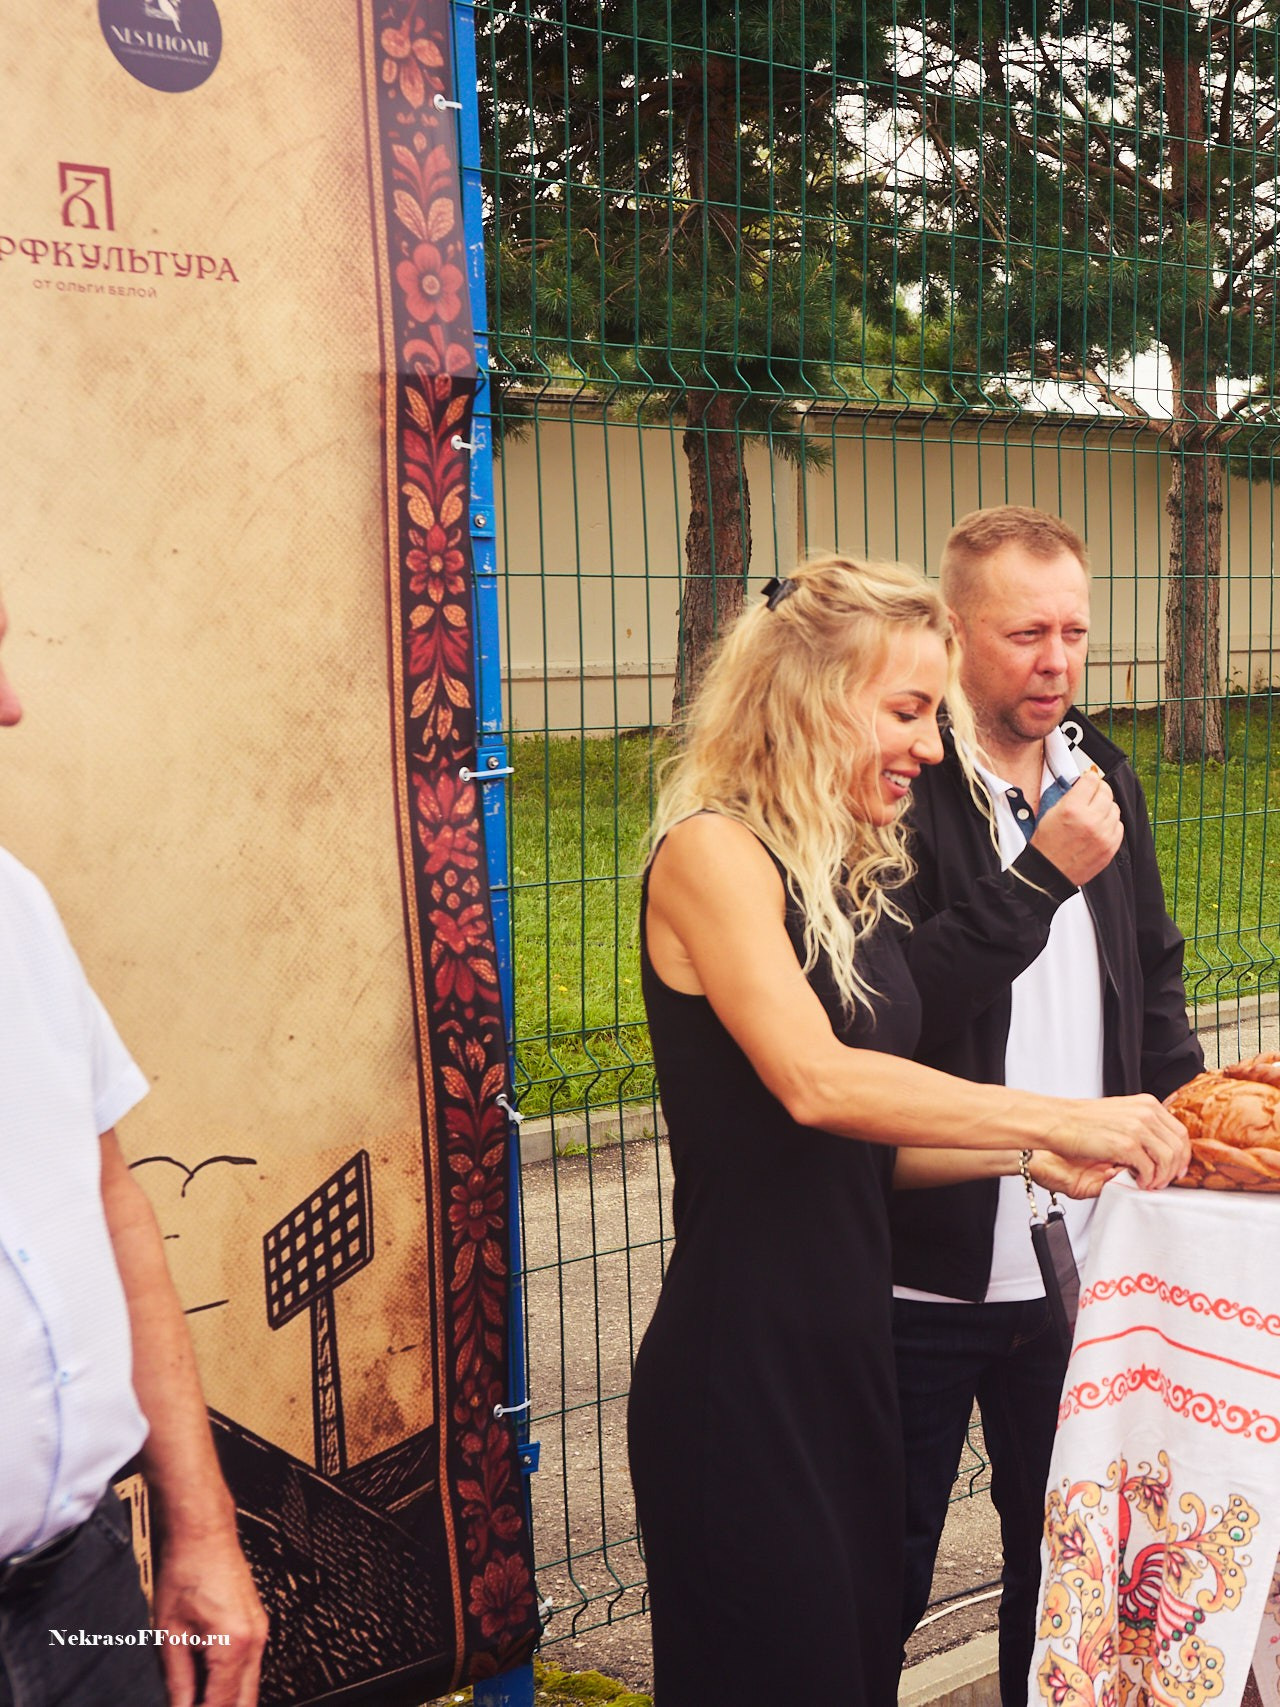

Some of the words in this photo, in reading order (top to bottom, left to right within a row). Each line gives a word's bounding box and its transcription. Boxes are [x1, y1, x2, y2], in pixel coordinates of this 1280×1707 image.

[32, 279, 51, 290] ОТ
[56, 281, 105, 295] ОЛЬГИ
[109, 284, 158, 299] БЕЛОЙ
